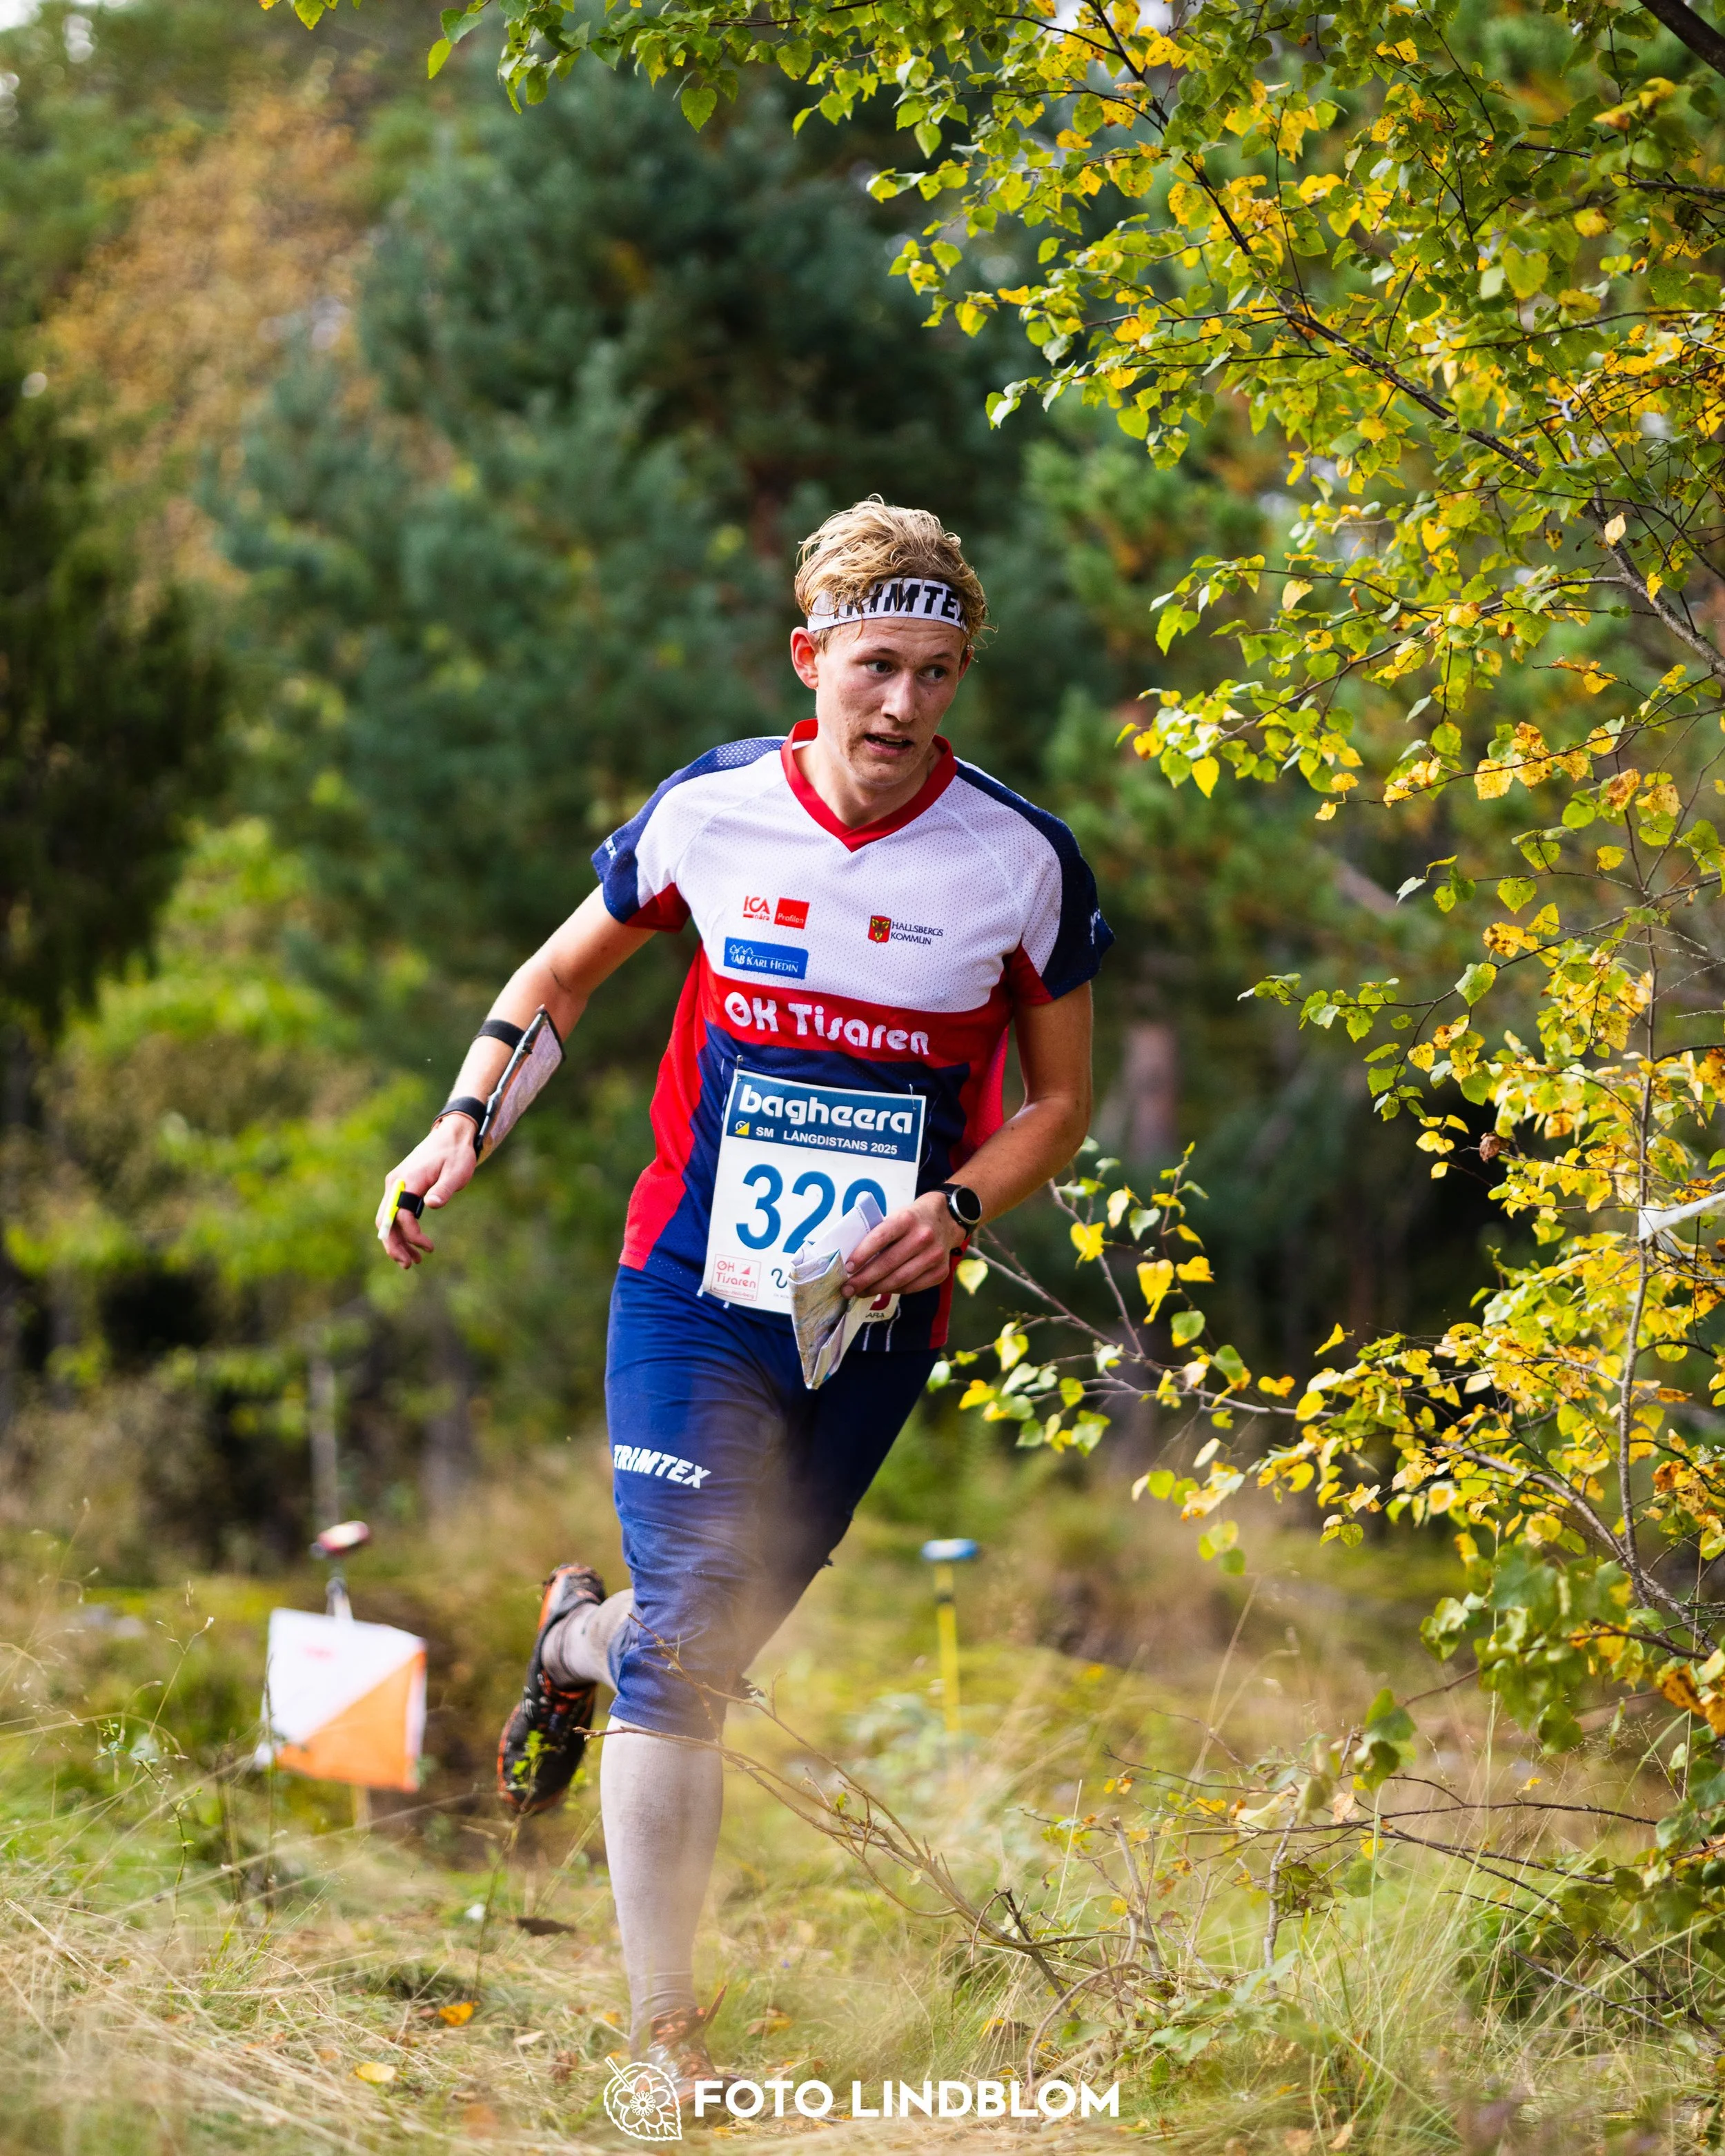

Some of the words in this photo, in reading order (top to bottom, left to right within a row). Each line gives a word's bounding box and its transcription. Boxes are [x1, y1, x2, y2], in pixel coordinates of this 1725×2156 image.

[743, 895, 771, 915] ICA
[777, 912, 805, 924] Profilen
[891, 921, 944, 936] HALLSBERGS
[891, 932, 932, 945] KOMMUN
[733, 953, 745, 965] AB
[746, 956, 768, 968] KARL
[770, 960, 799, 973] HEDIN
[724, 991, 779, 1032] OK
[788, 1002, 929, 1056] Tisaren
[738, 1085, 914, 1134] bagheera
[756, 1127, 774, 1138] SM
[870, 1142, 898, 1155] 2025
[716, 1272, 758, 1289] Tisaren
[613, 1444, 712, 1489] TRIMTEX
